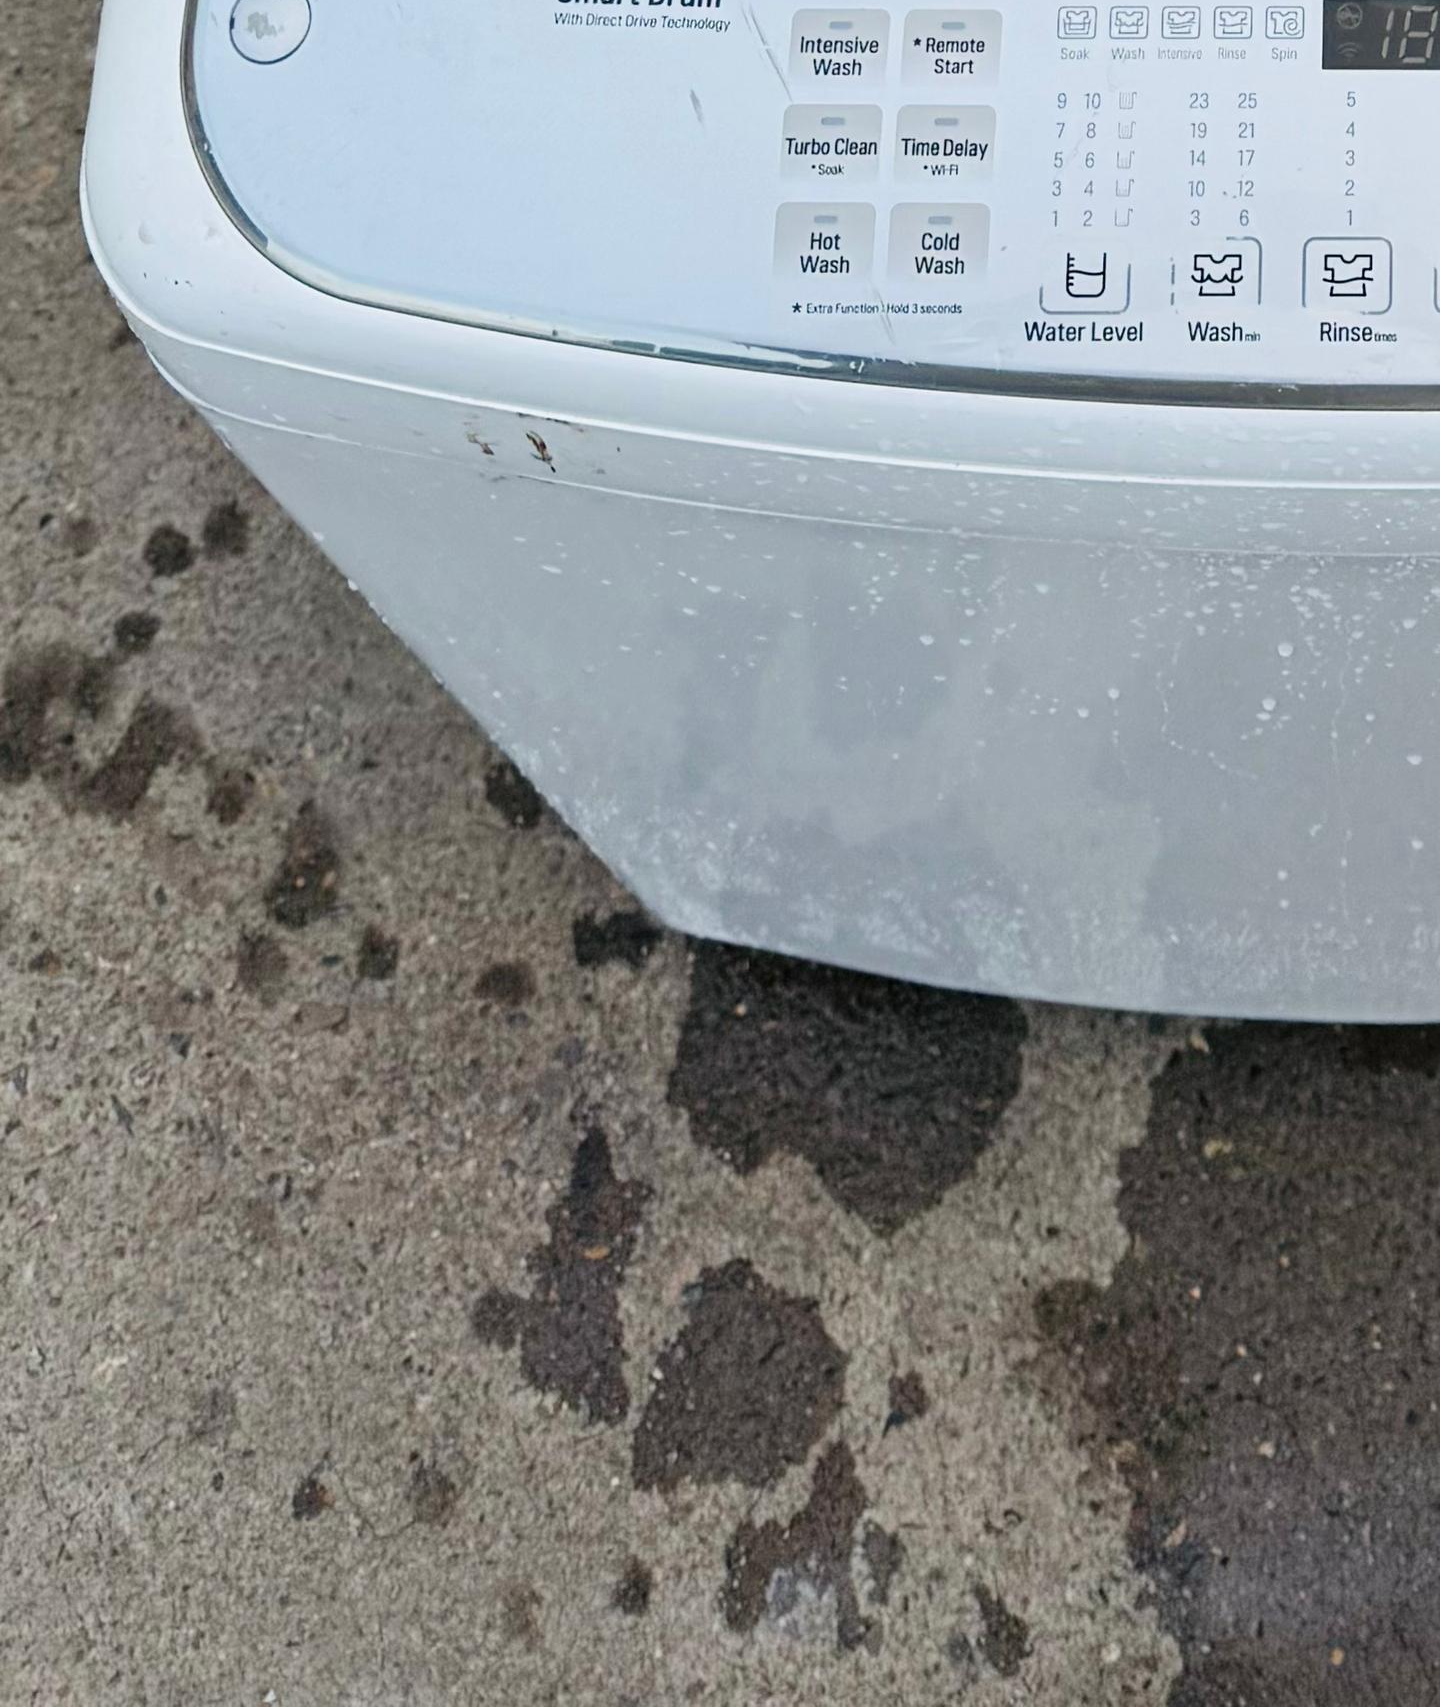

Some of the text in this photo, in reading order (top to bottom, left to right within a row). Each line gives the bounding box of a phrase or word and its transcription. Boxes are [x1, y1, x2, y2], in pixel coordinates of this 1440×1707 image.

[554, 12, 731, 33] With Direct Drive Technology
[800, 36, 879, 54] Intensive
[925, 37, 986, 54] Remote
[1060, 47, 1090, 60] Soak
[1111, 47, 1145, 61] Wash
[1217, 46, 1247, 60] Rinse
[1271, 47, 1298, 62] Spin
[812, 58, 862, 76] Wash
[933, 58, 974, 75] Start
[1057, 92, 1102, 110] 9 10
[1189, 92, 1258, 110] 23 25
[1346, 91, 1357, 108] 5
[1056, 122, 1097, 139] 7 8
[1190, 121, 1255, 139] 19 21
[1345, 121, 1355, 137] 4
[785, 137, 878, 156] Turbo Clean
[900, 137, 989, 161] Time Delay
[1053, 151, 1095, 169] 5 6
[1189, 149, 1256, 167] 14 17
[1345, 149, 1356, 167] 3
[1051, 179, 1094, 197] 3 4
[1188, 180, 1255, 198] 10 12
[1344, 179, 1355, 197] 2
[1052, 209, 1093, 227] 1 2
[1190, 208, 1250, 227] 3 6
[1347, 209, 1353, 226] 1
[810, 232, 841, 251] Hot
[921, 232, 960, 251] Cold
[799, 255, 850, 274] Wash
[914, 256, 965, 275] Wash
[806, 302, 833, 315] Extra
[886, 303, 910, 314] Hold
[911, 303, 919, 314] 3
[919, 303, 963, 315] seconds
[1024, 321, 1144, 342] Water Level
[1187, 321, 1247, 342] Wash
[1320, 321, 1373, 342] Rinse
